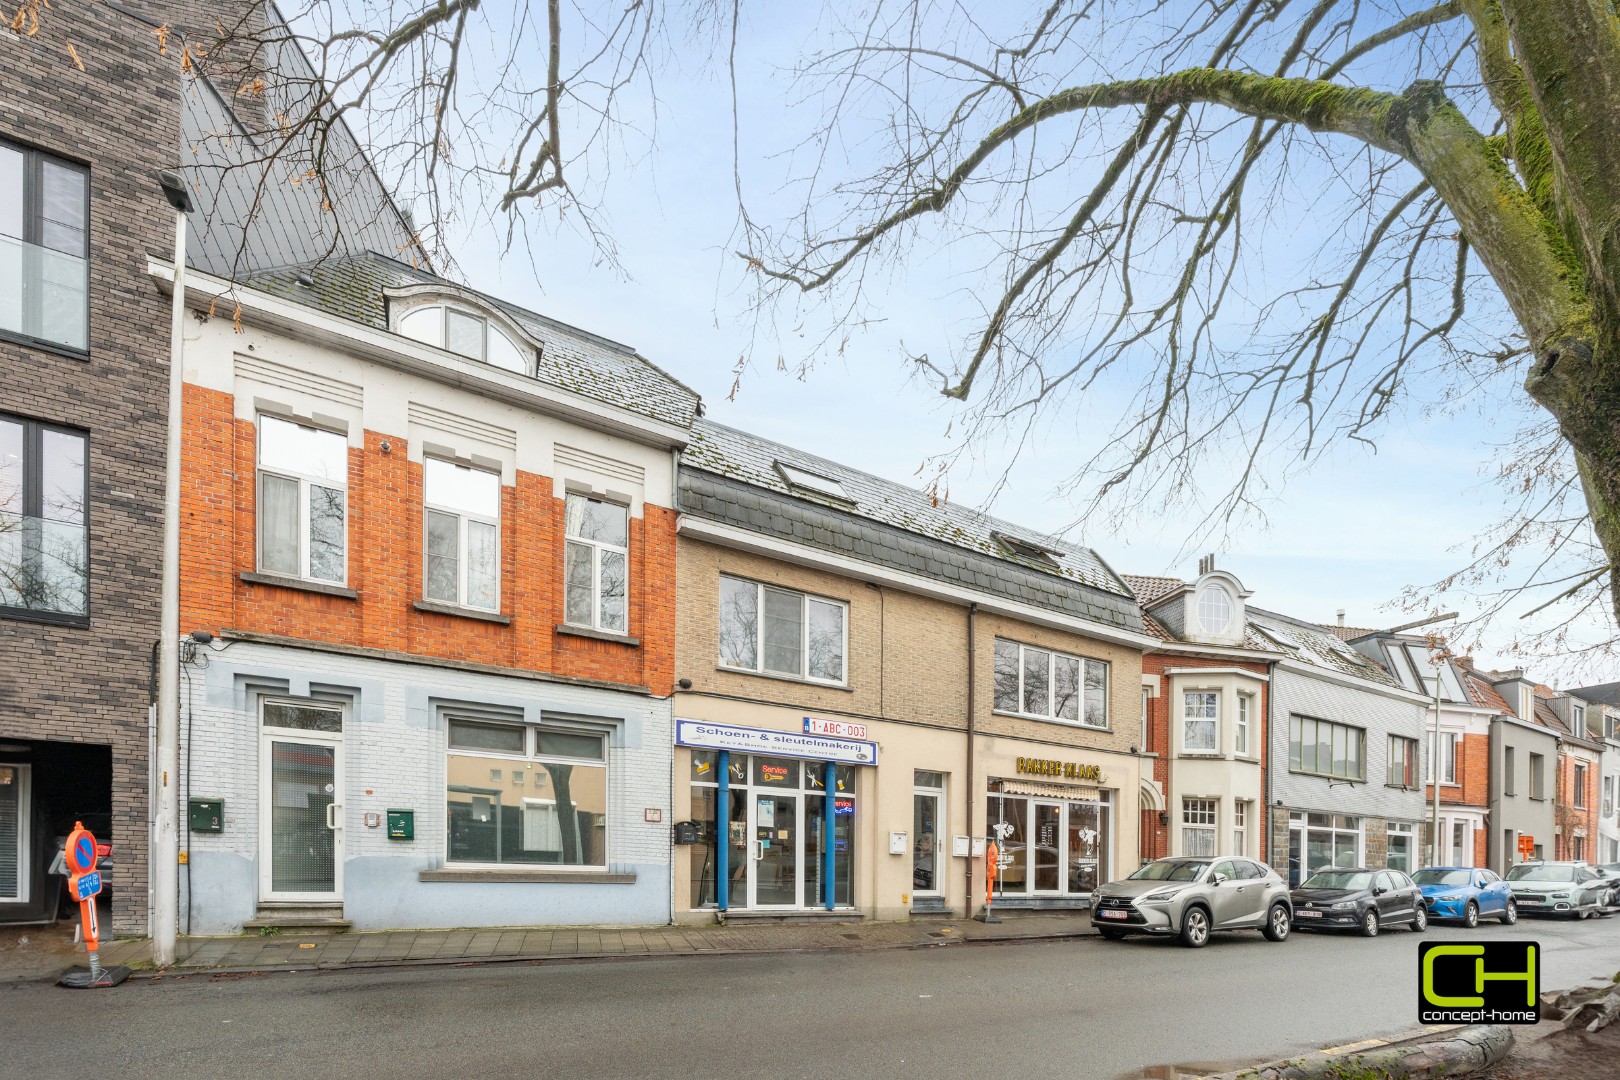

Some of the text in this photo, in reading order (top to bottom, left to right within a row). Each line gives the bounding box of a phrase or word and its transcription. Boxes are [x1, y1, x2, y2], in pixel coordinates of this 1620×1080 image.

[812, 720, 865, 737] 1-ABC-003
[696, 726, 862, 752] Schoen- & sleutelmakerij
[762, 764, 788, 775] Service
[1018, 757, 1101, 781] BAKKER KLAAS
